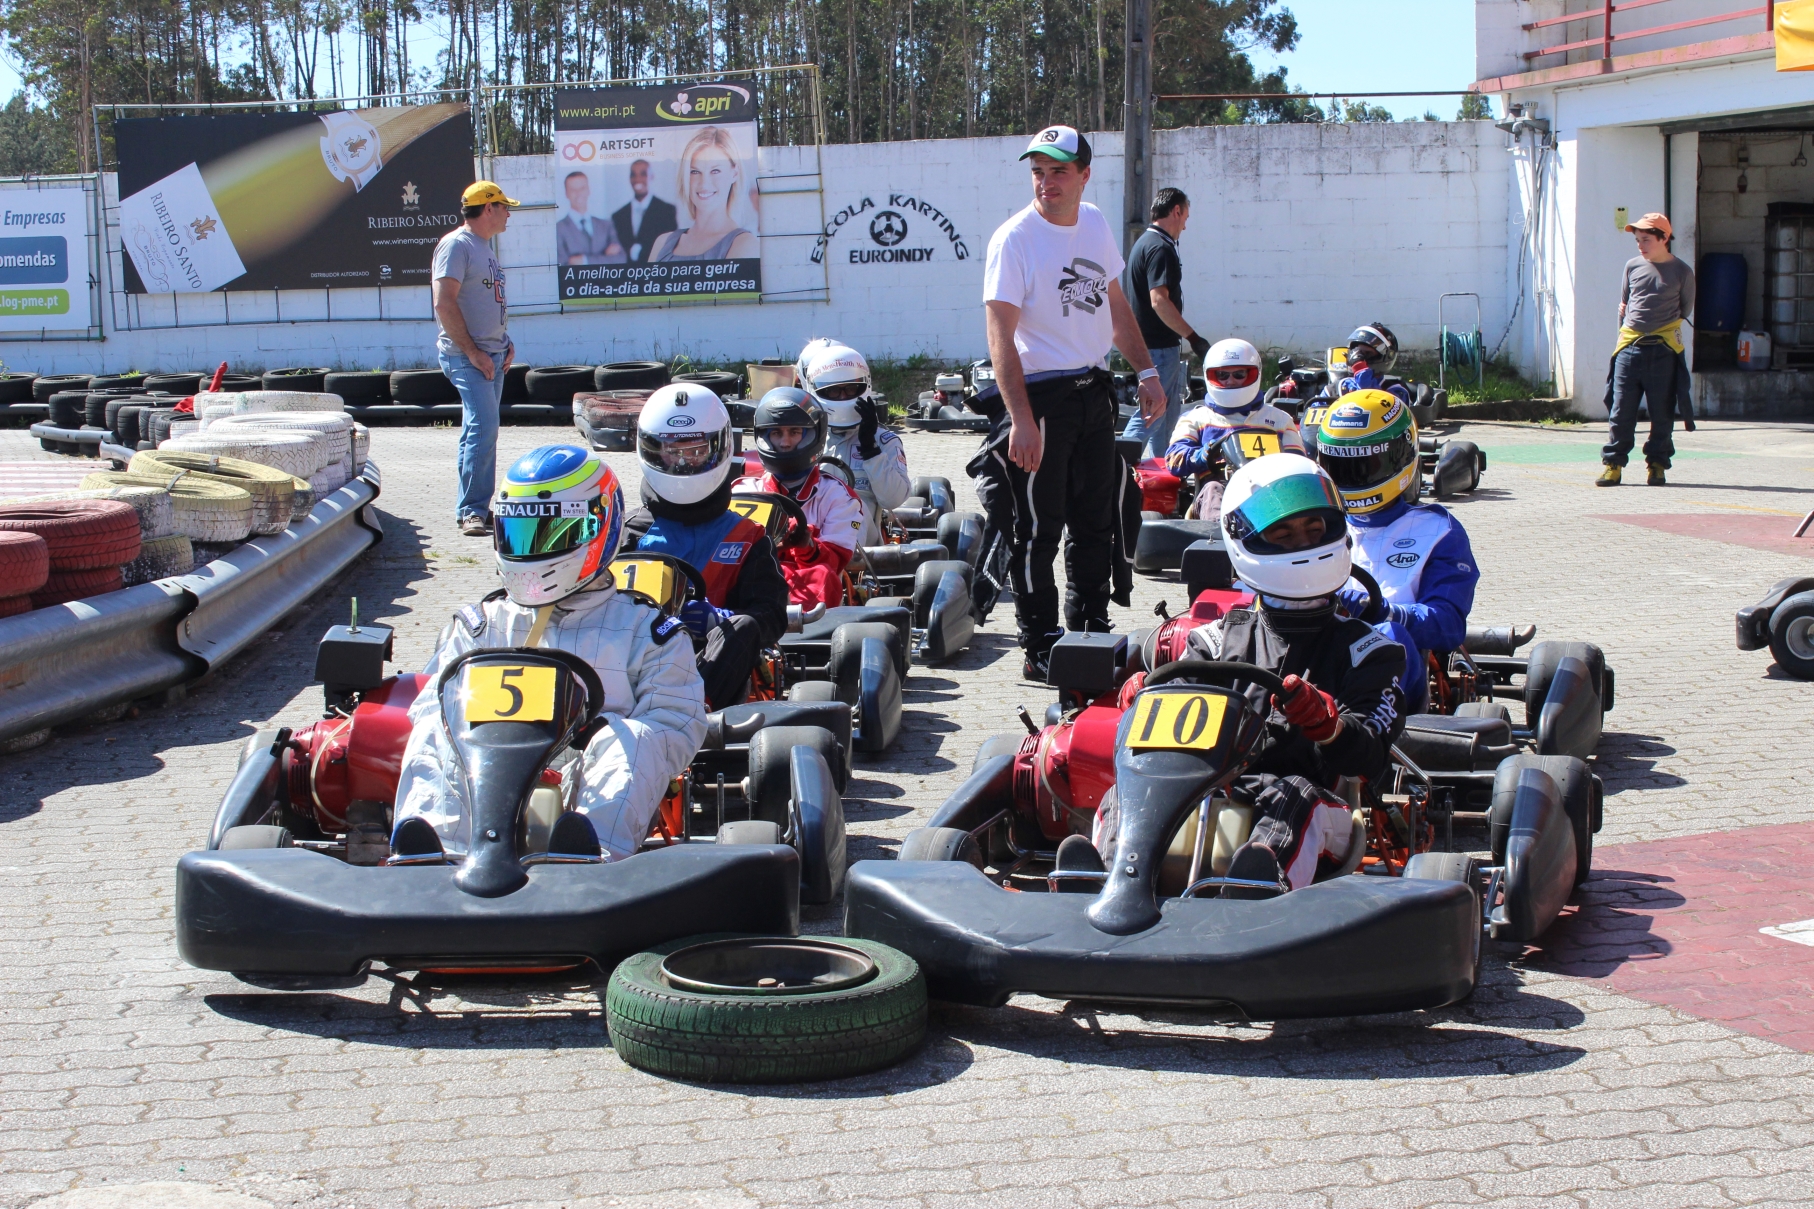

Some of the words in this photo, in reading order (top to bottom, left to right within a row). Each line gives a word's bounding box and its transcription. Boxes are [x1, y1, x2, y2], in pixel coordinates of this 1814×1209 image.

[560, 105, 635, 118] www.apri.pt
[695, 92, 732, 115] apri
[600, 138, 654, 150] ARTSOFT
[325, 150, 338, 172] BRUTO
[4, 210, 66, 229] Empresas
[368, 217, 414, 229] RIBEIRO
[418, 215, 458, 227] SANTO
[811, 197, 874, 264] ESCOLA
[889, 194, 969, 260] KARTING
[150, 192, 181, 246] RIBEIRO
[174, 246, 203, 289] SANTO
[144, 245, 156, 267] BRUTO
[850, 248, 935, 263] EUROINDY
[565, 268, 575, 280] A
[578, 266, 624, 280] melhor
[627, 264, 668, 281] opção
[671, 264, 701, 279] para
[705, 261, 740, 278] gerir
[566, 286, 575, 296] o
[579, 282, 639, 296] dia-a-dia
[649, 281, 660, 293] da
[664, 281, 690, 293] sua
[694, 279, 756, 294] empresa
[1252, 435, 1266, 457] 4
[1324, 445, 1369, 456] RENAULT
[1373, 443, 1389, 453] elf
[495, 504, 558, 516] RENAULT
[735, 503, 758, 518] 7
[622, 564, 637, 590] 1
[494, 666, 524, 717] 5
[1139, 695, 1209, 745] 10
